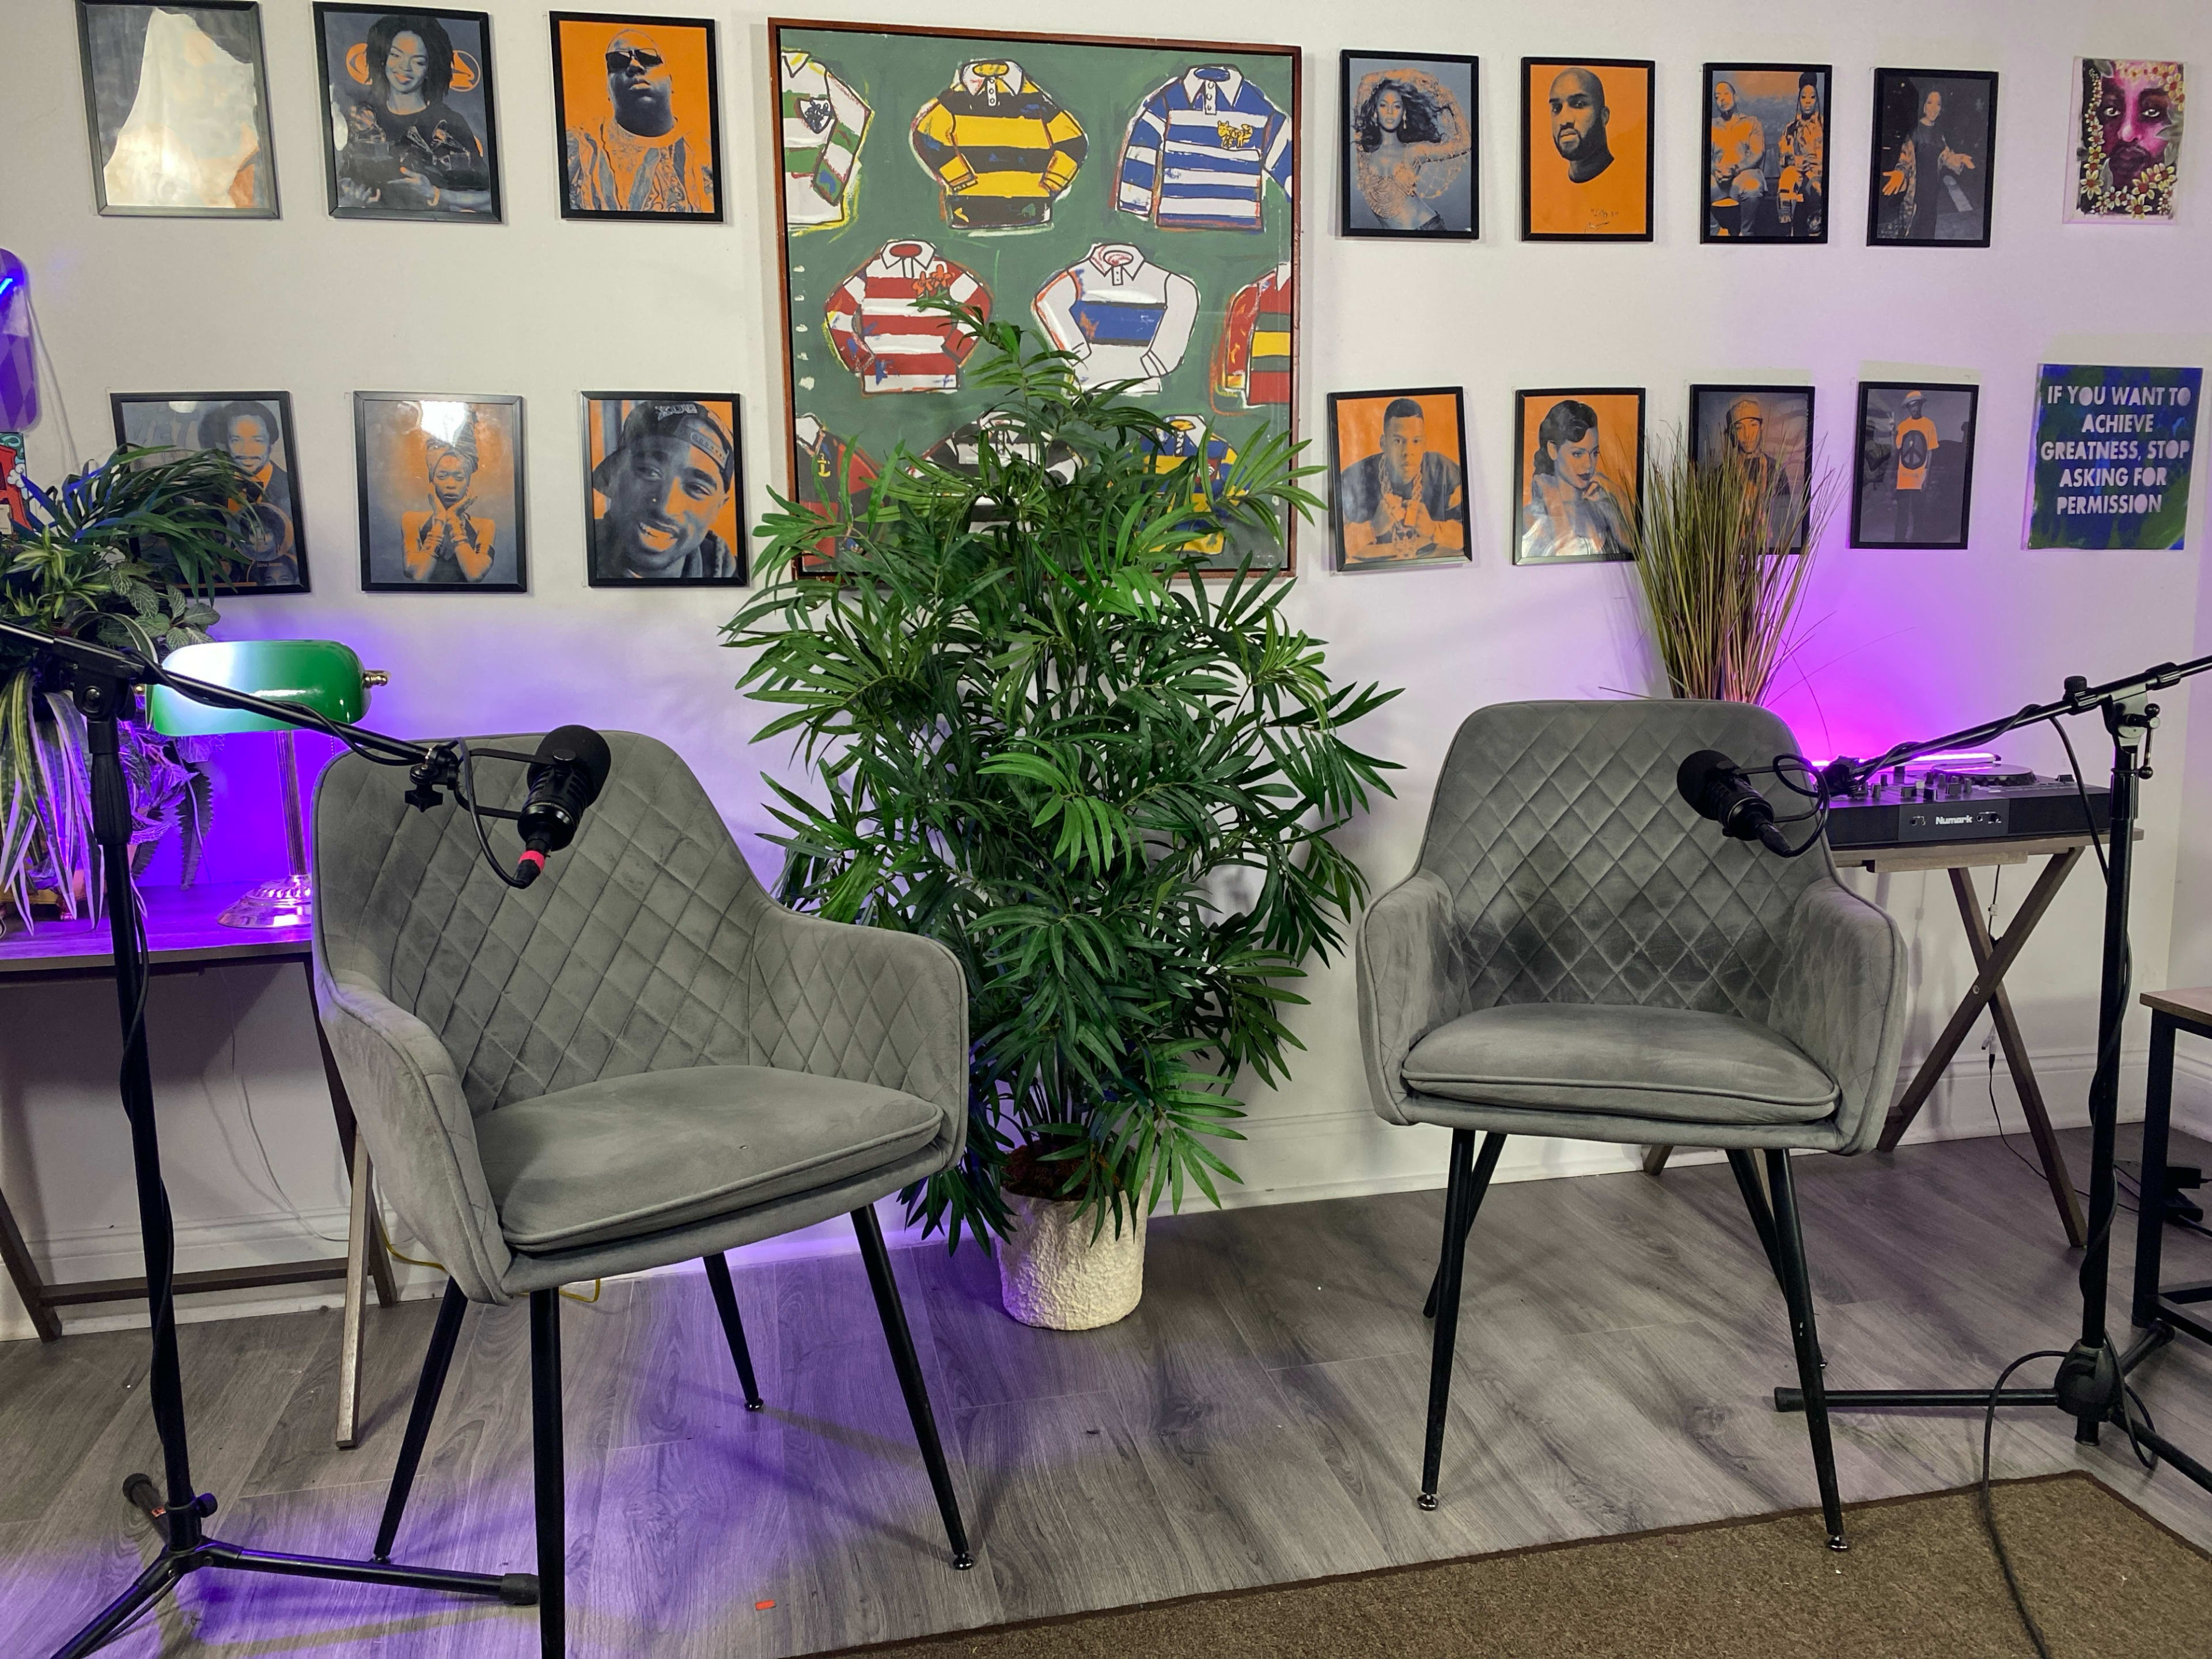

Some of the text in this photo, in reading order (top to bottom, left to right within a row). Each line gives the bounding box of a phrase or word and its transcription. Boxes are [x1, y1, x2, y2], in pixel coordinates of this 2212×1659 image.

[2048, 385, 2191, 407] IF YOU WANT TO
[2082, 414, 2154, 433] ACHIEVE
[2041, 440, 2190, 460] GREATNESS, STOP
[2059, 467, 2168, 487] ASKING FOR
[2056, 494, 2162, 514] PERMISSION
[1936, 815, 1972, 824] Numark
